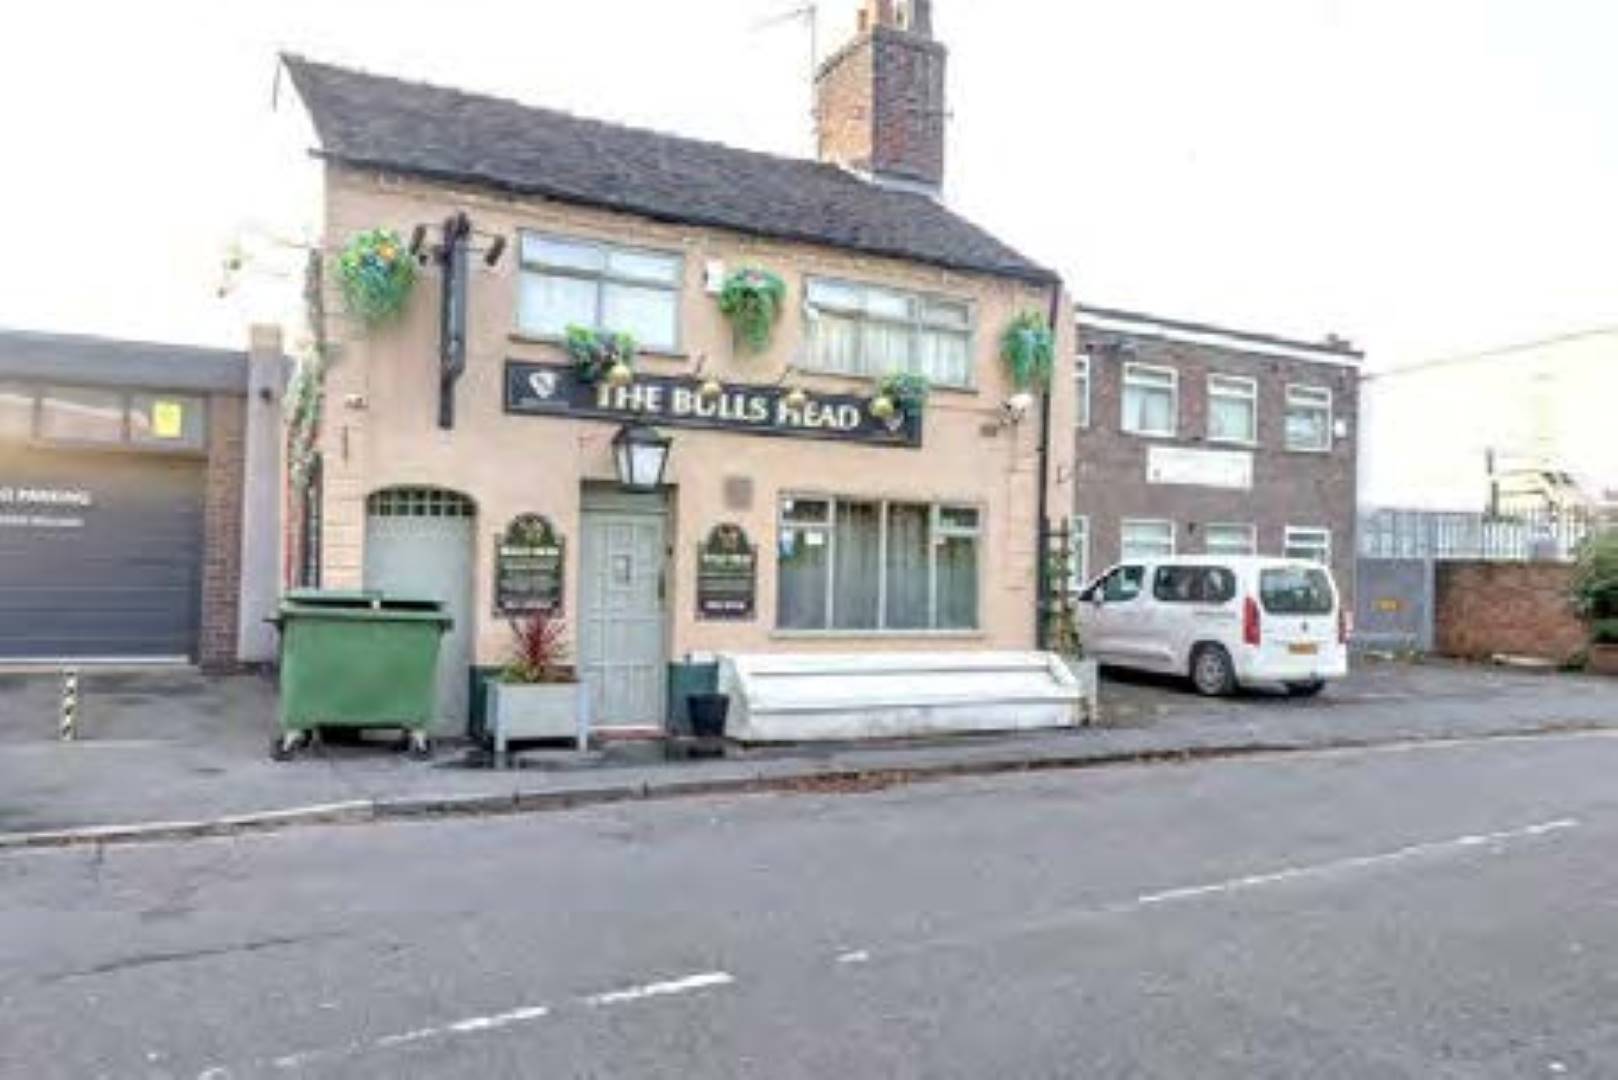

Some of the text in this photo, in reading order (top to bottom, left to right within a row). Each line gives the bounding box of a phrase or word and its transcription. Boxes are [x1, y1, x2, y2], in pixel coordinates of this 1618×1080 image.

[596, 382, 663, 413] THE
[671, 386, 769, 420] BULLS
[776, 396, 860, 431] HEAD
